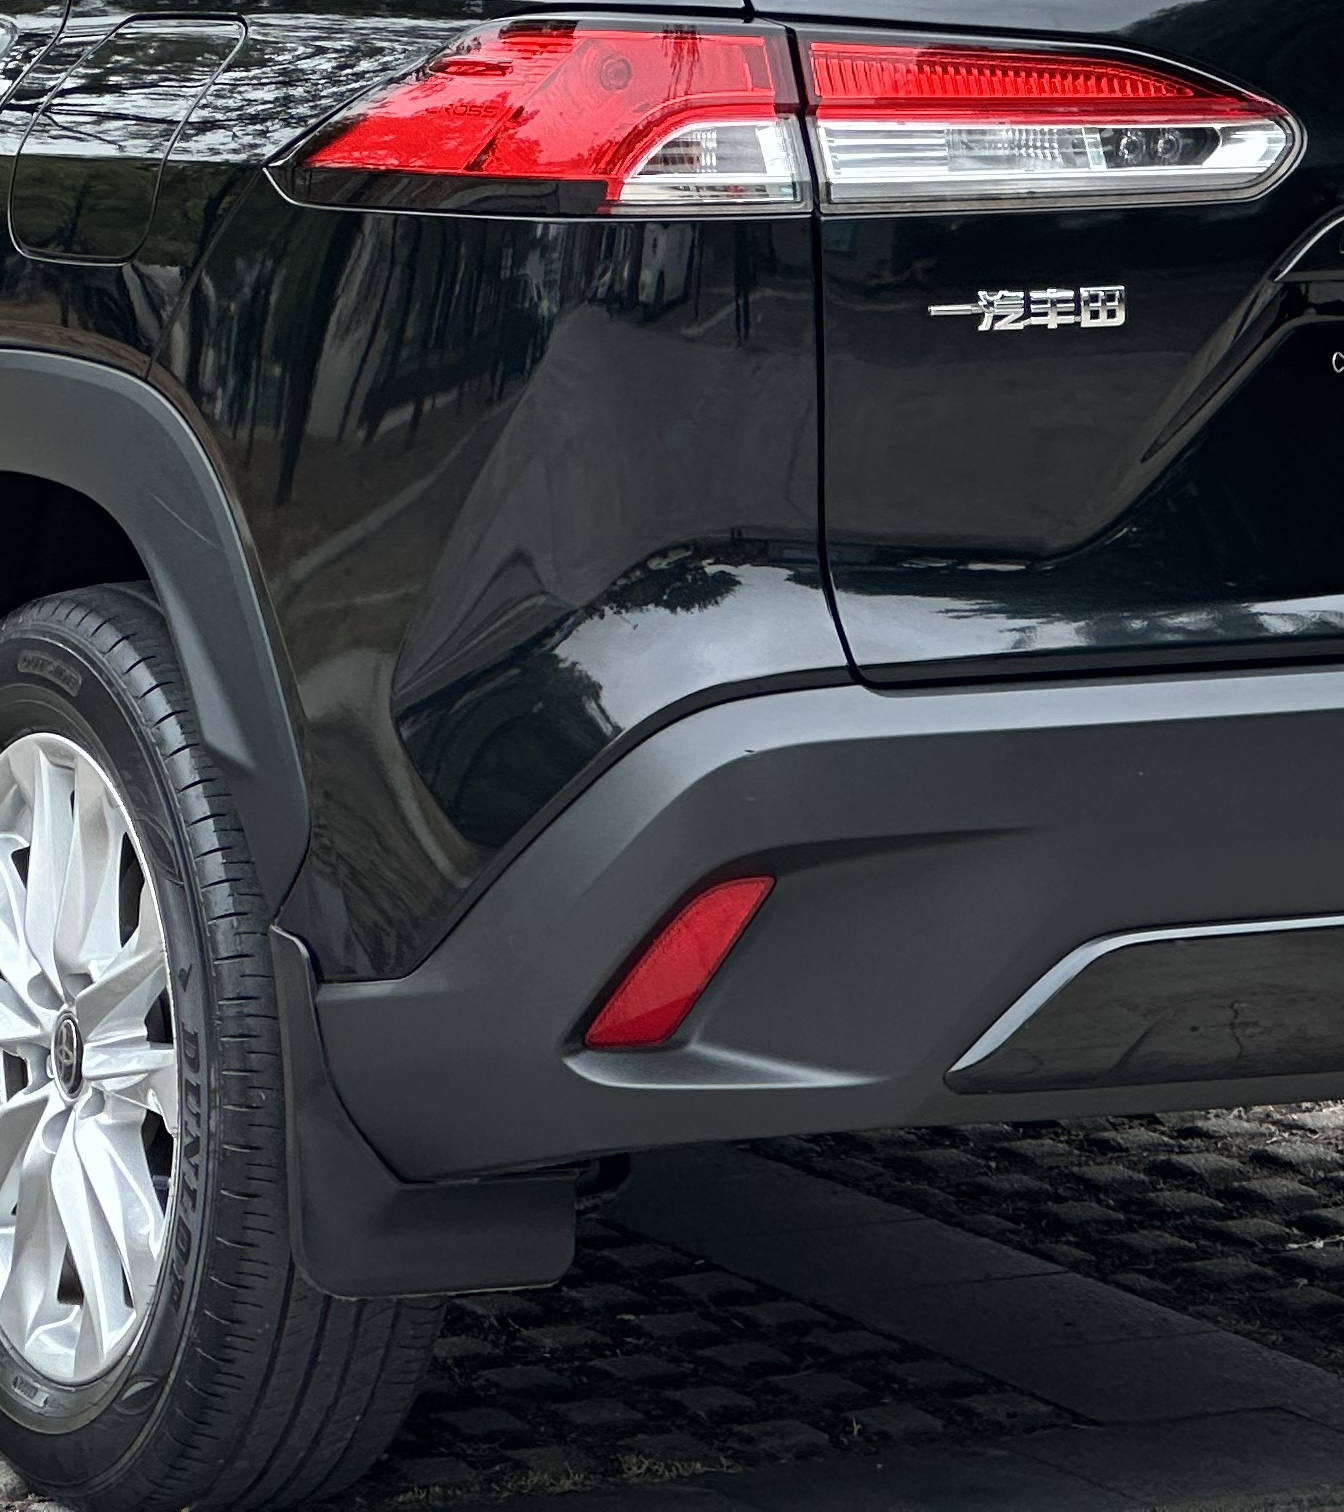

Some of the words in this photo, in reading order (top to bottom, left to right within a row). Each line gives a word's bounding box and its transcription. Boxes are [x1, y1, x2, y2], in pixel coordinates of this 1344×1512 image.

[927, 285, 1126, 332] 一汽丰田
[169, 1021, 202, 1315] DUNLOP
